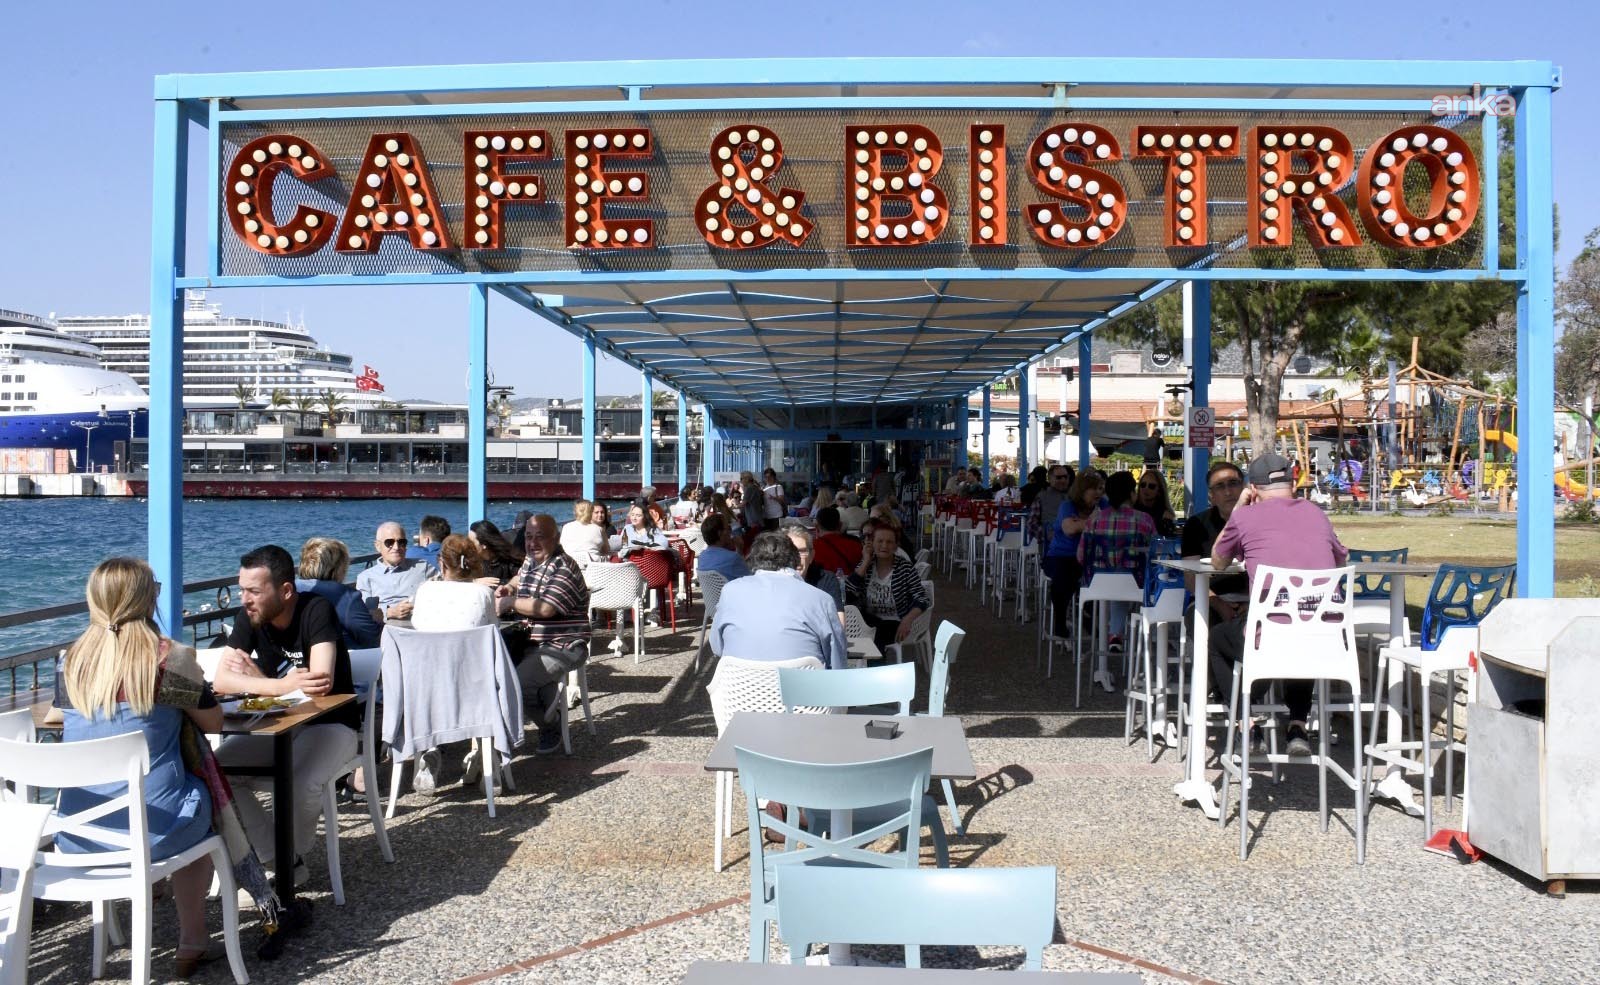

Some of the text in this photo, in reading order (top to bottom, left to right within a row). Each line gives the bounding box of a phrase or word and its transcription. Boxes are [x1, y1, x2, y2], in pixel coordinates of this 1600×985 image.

[226, 124, 1482, 258] CAFE & BISTRO
